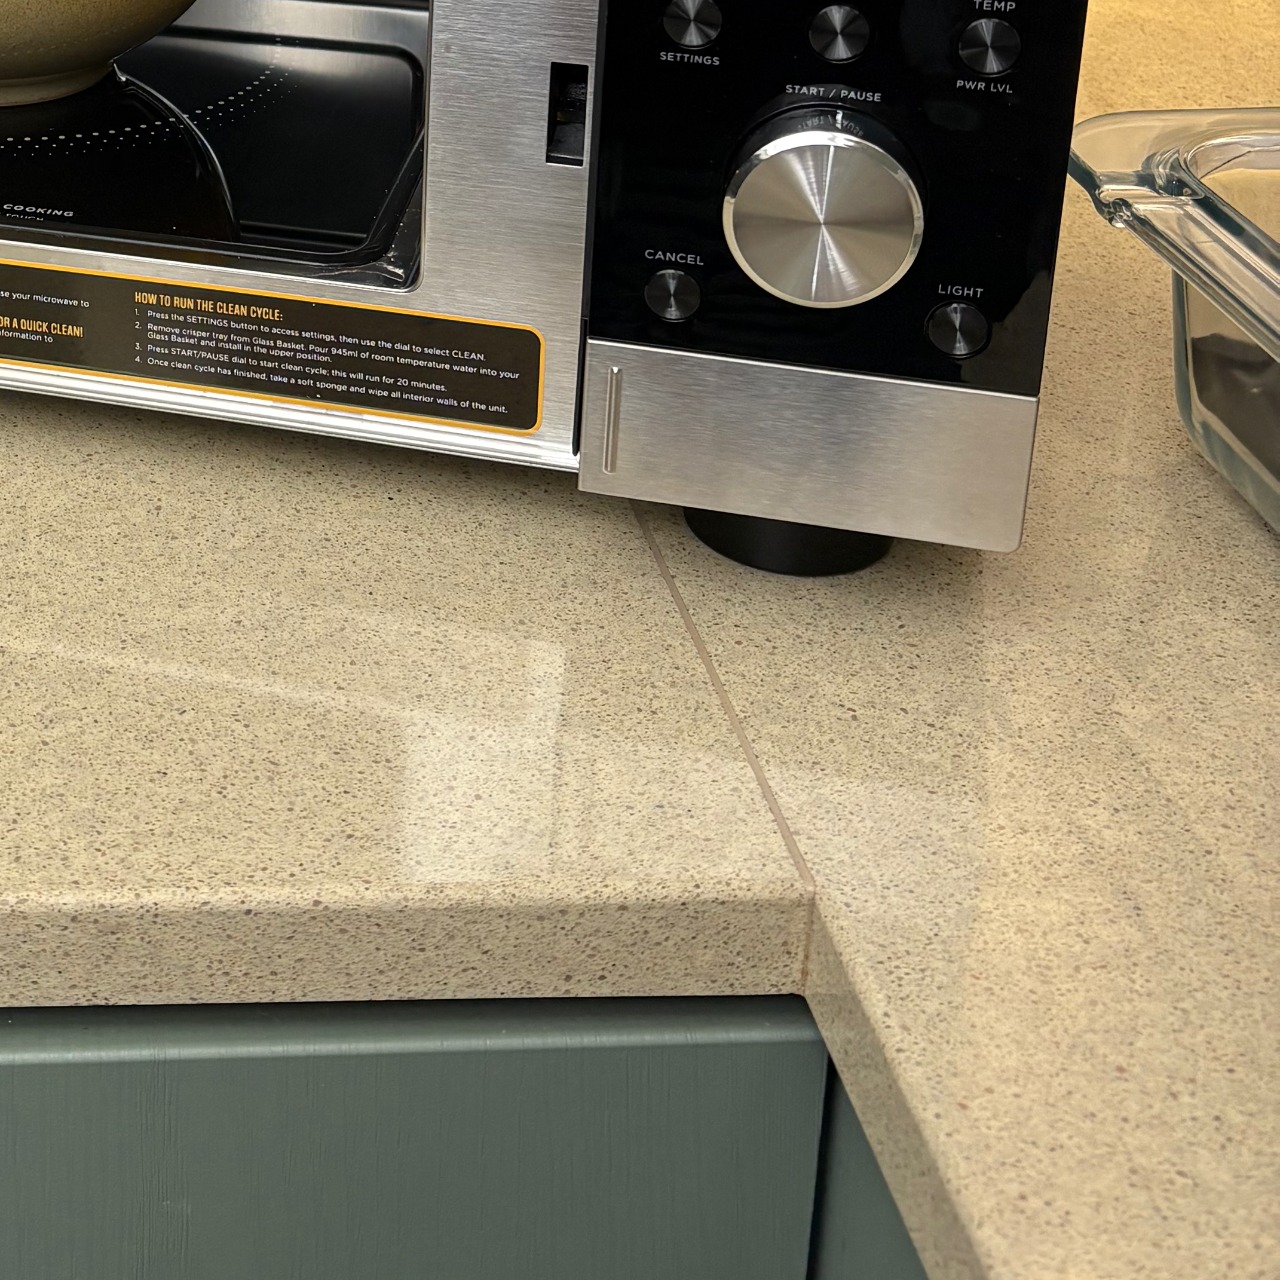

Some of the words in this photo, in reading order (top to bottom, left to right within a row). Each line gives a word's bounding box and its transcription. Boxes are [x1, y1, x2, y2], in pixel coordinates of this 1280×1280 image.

[660, 51, 720, 66] SETTINGS
[785, 84, 825, 96] START
[840, 89, 881, 102] PAUSE
[956, 79, 986, 90] PWR
[990, 82, 1012, 93] LVL
[3, 203, 74, 217] COOKING
[644, 249, 704, 265] CANCEL
[938, 284, 984, 298] LIGHT
[135, 291, 157, 304] HOW
[159, 294, 171, 307] TO
[173, 296, 194, 309] RUN
[196, 299, 214, 312] THE
[216, 301, 248, 316] CLEAN
[250, 306, 283, 321] CYCLE:
[12, 318, 18, 329] A
[20, 318, 48, 333] QUICK
[50, 322, 83, 338] CLEAN!
[147, 310, 169, 319] Press
[170, 313, 184, 322] the
[186, 315, 228, 327] SETTINGS
[230, 320, 258, 331] button
[271, 327, 300, 336] access
[301, 331, 337, 342] settings,
[339, 335, 359, 344] then
[360, 339, 376, 347] use
[378, 340, 392, 349] the
[394, 342, 410, 351] dial
[412, 345, 422, 353] to
[423, 347, 450, 357] select
[451, 349, 486, 361] CLEAN.
[147, 344, 169, 354] Press
[170, 347, 229, 362] START/PAUSE
[231, 356, 246, 364] dial
[259, 360, 278, 368] start
[280, 362, 304, 372] clean
[305, 366, 330, 376] cycle;
[331, 369, 347, 378] this
[349, 372, 364, 380] will
[382, 375, 394, 384] for
[396, 377, 408, 386] 20
[410, 381, 447, 391] minutes.
